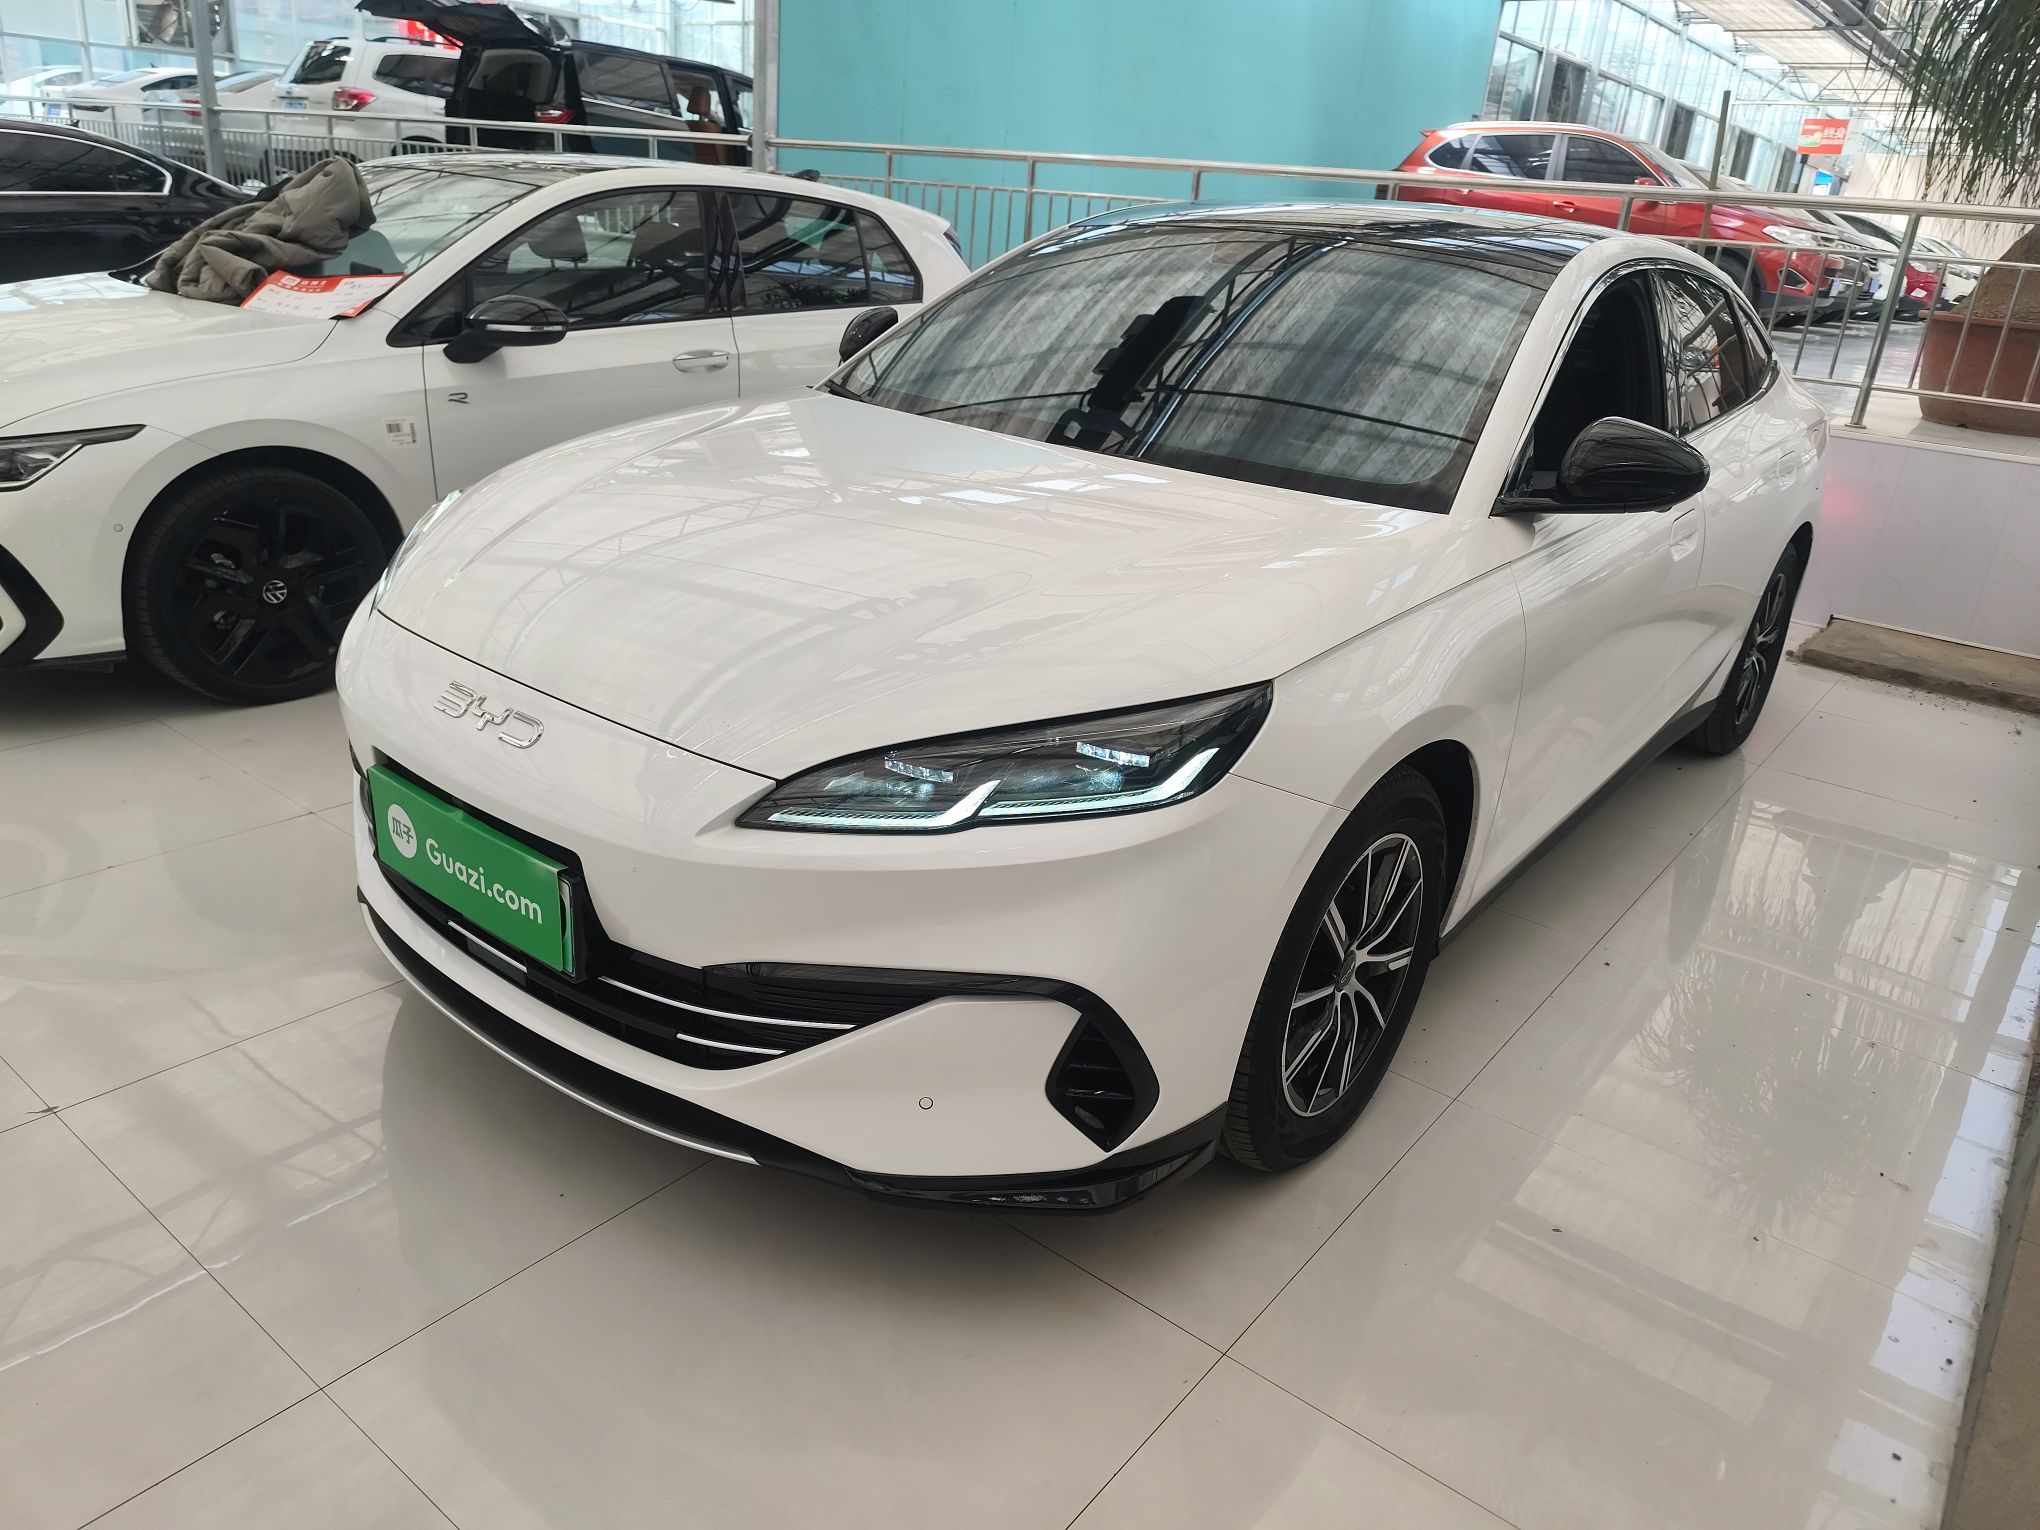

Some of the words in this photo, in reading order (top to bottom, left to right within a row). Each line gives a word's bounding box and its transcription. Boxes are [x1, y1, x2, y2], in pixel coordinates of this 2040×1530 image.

[433, 680, 545, 749] BYD
[391, 816, 414, 845] 瓜子
[425, 837, 543, 925] Guazi.com
